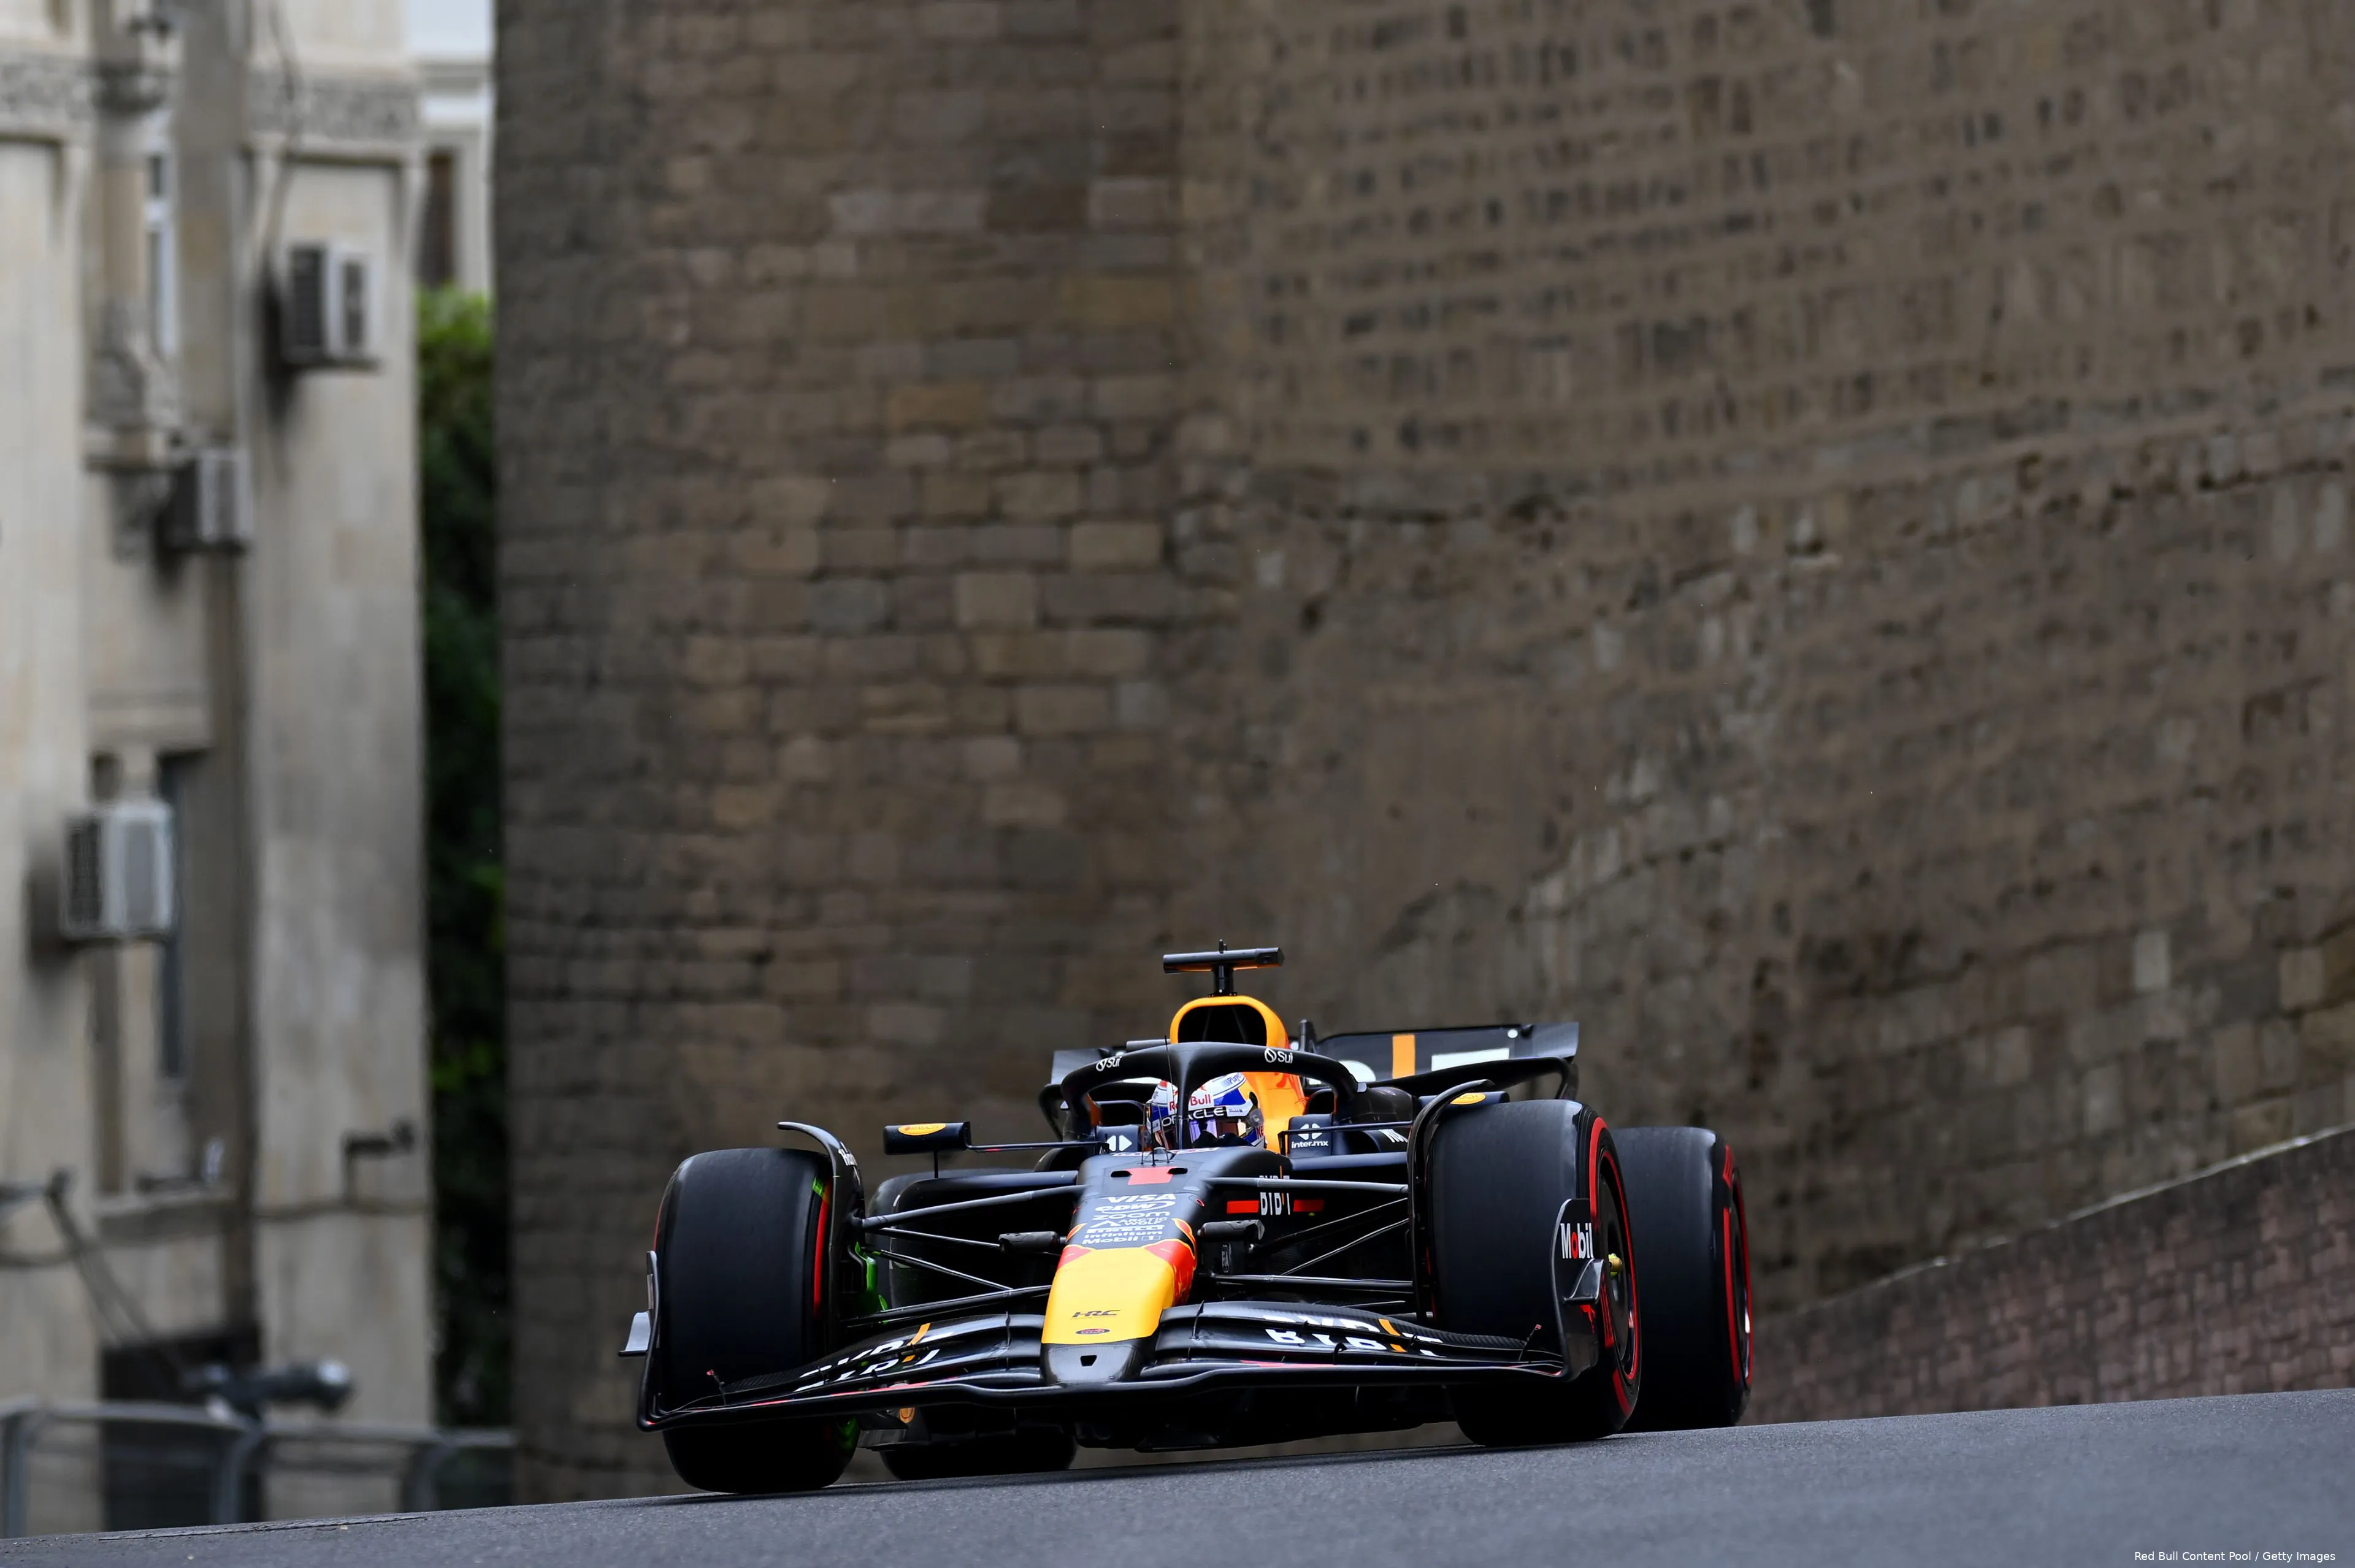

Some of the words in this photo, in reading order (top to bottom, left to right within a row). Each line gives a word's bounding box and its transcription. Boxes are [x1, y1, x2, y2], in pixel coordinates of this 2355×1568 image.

[1106, 1056, 1123, 1068] Sui
[1277, 1051, 1293, 1064] Sui
[1190, 1094, 1212, 1106] Bull
[1104, 1193, 1176, 1203] VISA
[1092, 1211, 1171, 1220] zoom
[1086, 1225, 1165, 1234] PIRELLI
[1082, 1236, 1138, 1245] Mobil
[1560, 1223, 1594, 1259] Mobil
[1072, 1309, 1120, 1318] HRC
